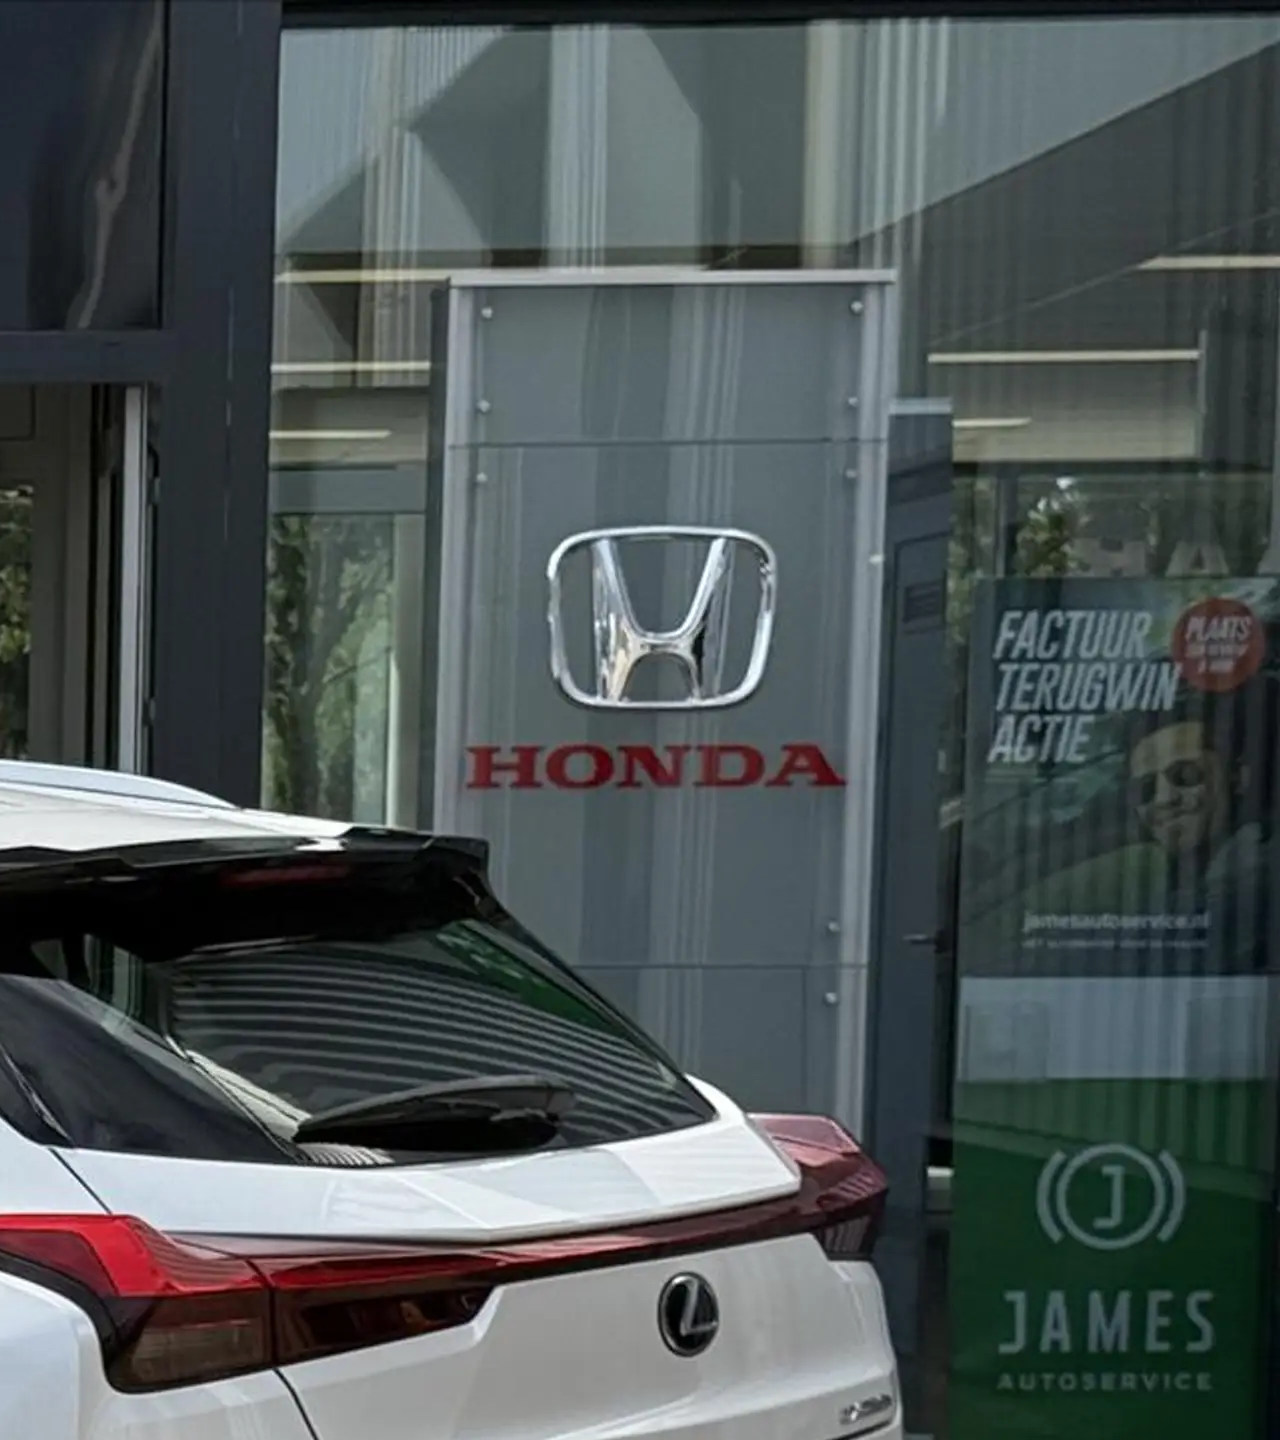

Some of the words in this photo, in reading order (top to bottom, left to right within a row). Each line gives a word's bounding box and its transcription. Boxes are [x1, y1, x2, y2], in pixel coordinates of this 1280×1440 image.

[992, 609, 1153, 660] FACTUUR
[995, 661, 1183, 712] TERUGWIN
[987, 714, 1095, 764] ACTIE
[466, 742, 848, 789] HONDA
[998, 1289, 1217, 1354] JAMES
[996, 1372, 1213, 1391] AUTOSERVICE
